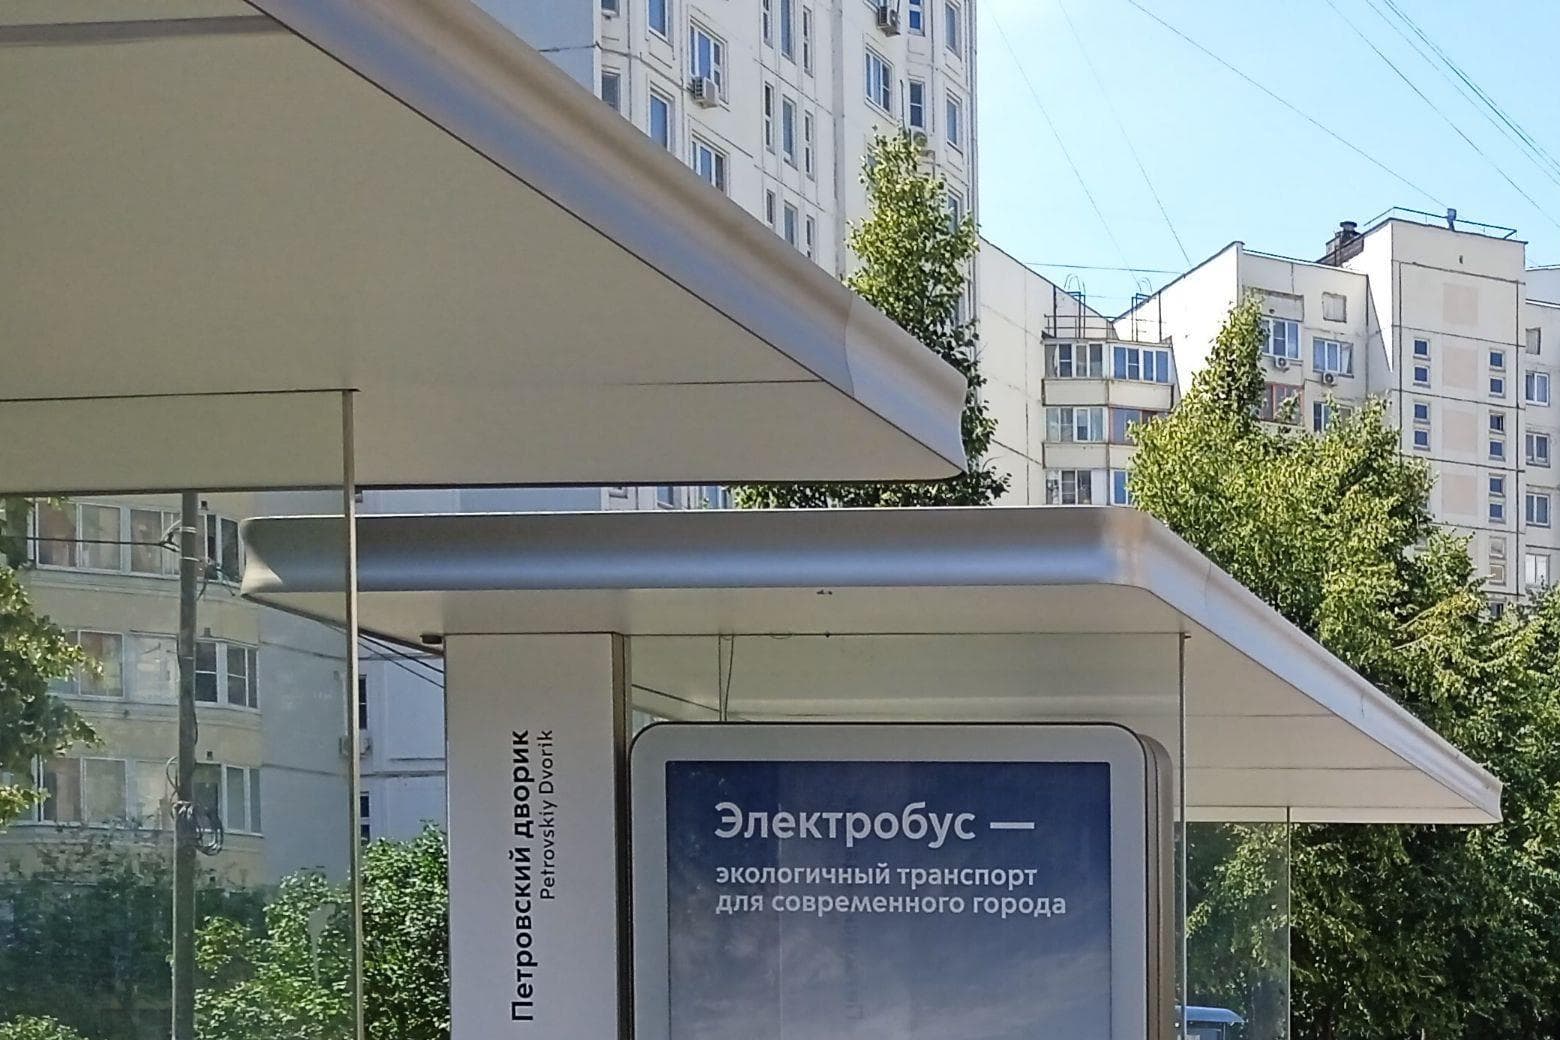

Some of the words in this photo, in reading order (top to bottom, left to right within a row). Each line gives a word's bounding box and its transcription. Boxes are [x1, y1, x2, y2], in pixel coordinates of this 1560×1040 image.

[512, 729, 535, 839] дворик
[536, 730, 555, 794] Dvorik
[538, 799, 558, 900] Petrovskiy
[714, 801, 976, 849] Электробус
[715, 863, 891, 886] экологичный
[897, 867, 1038, 889] транспорт
[715, 893, 764, 914] для
[771, 895, 965, 917] современного
[973, 897, 1067, 918] города
[508, 848, 539, 1021] Петровский
